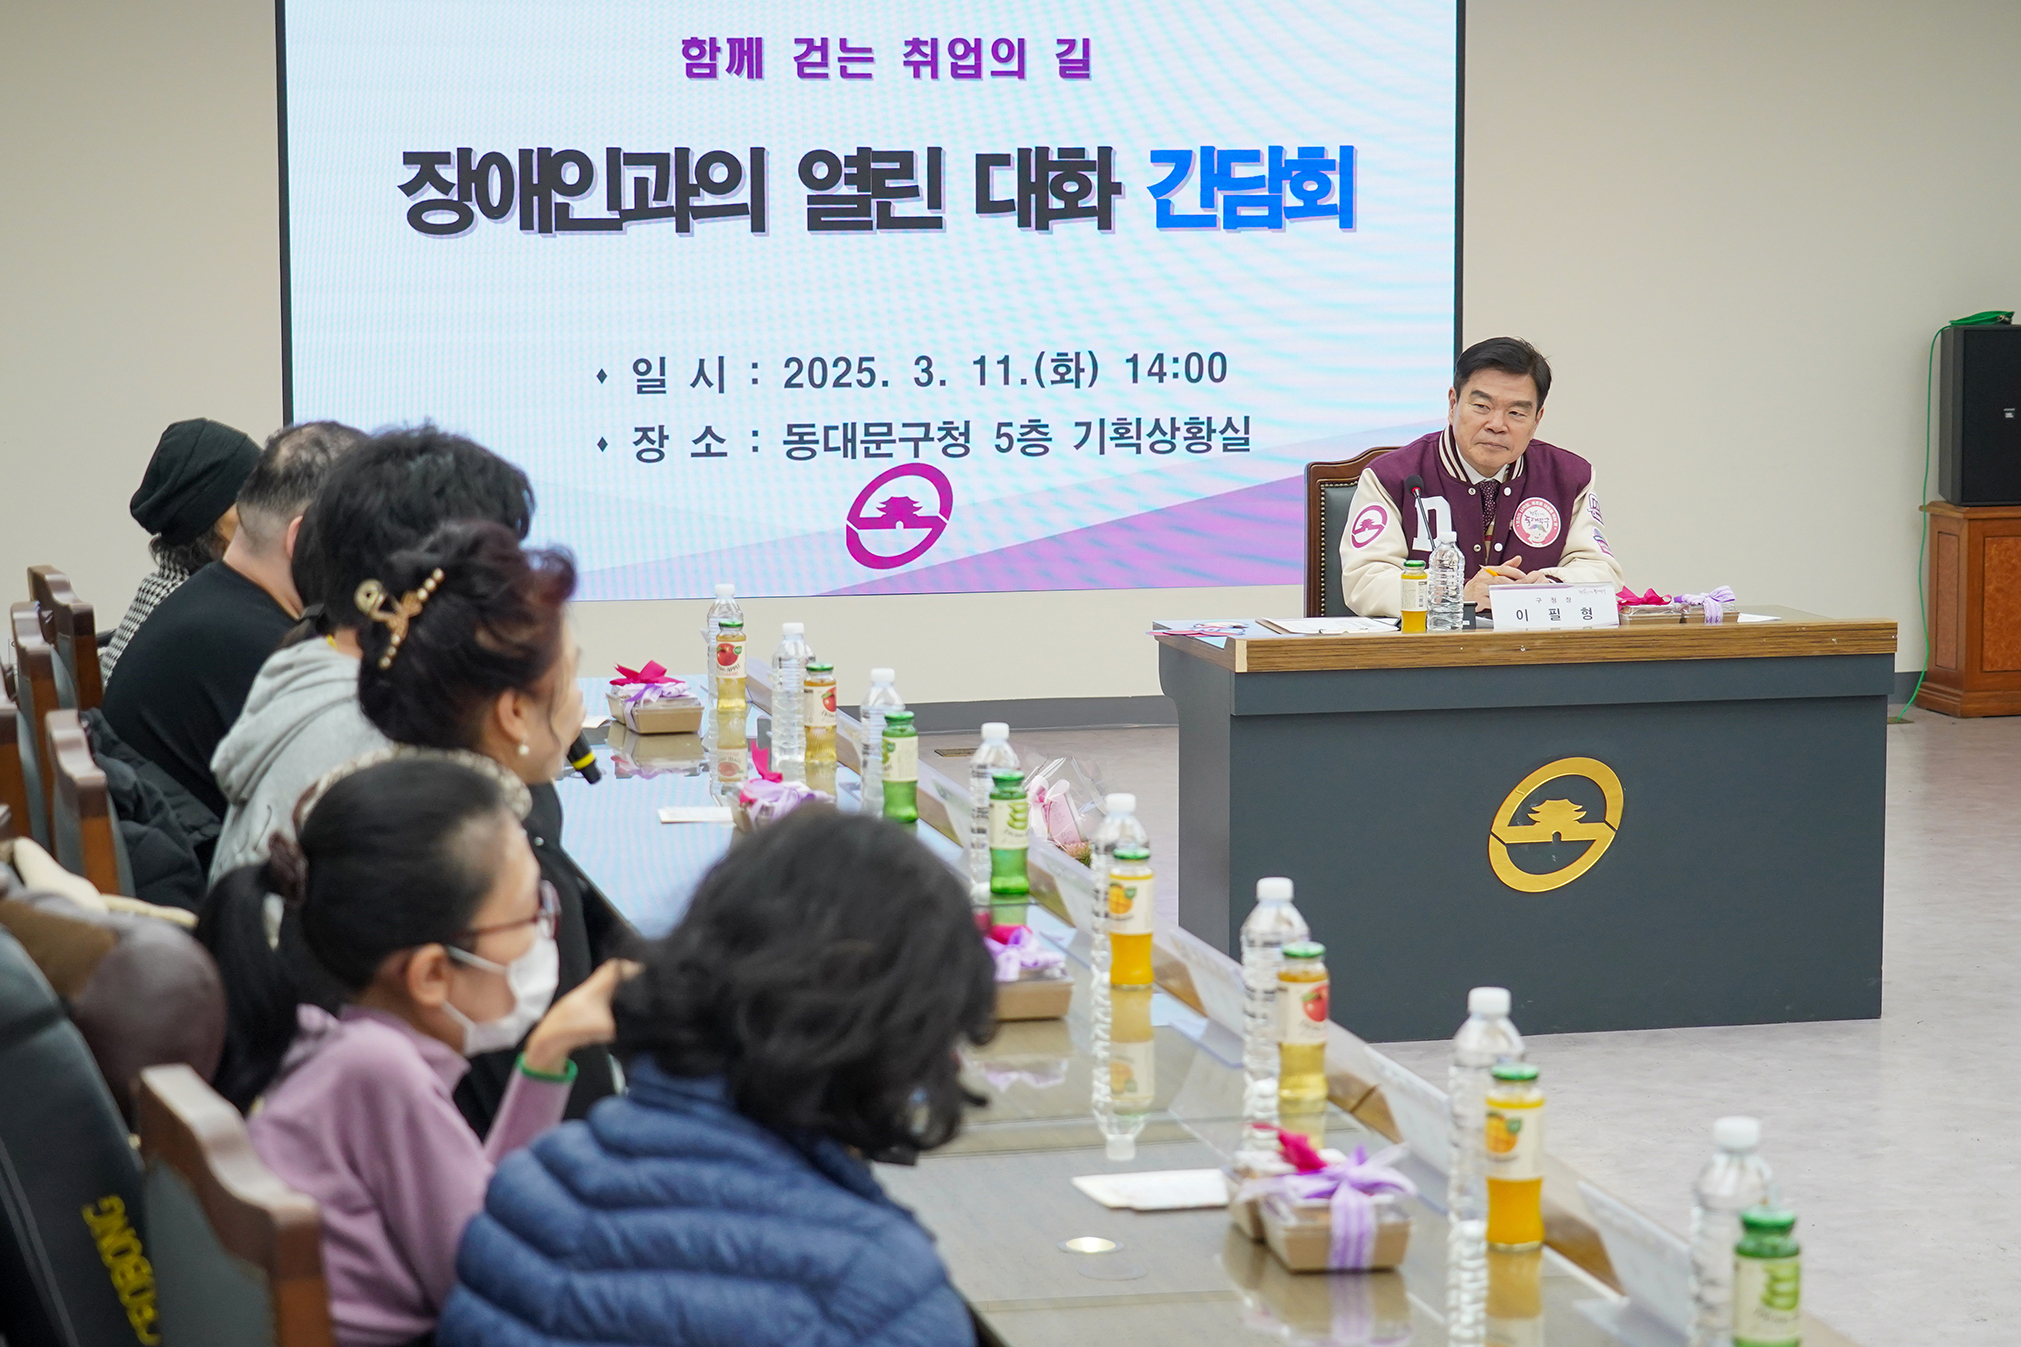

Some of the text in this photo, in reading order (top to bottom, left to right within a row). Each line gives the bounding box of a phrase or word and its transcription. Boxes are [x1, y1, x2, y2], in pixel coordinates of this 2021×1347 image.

[681, 37, 1092, 80] 함께 걷는 취업의 길
[397, 145, 1356, 236] 장애인과의 열린 대화 간담회
[632, 356, 667, 395] 일
[690, 356, 726, 394] 시
[784, 356, 890, 389] 2025.
[913, 356, 947, 387] 3.
[972, 350, 1099, 389] 11.(화)
[1125, 351, 1228, 384] 14:00
[632, 424, 670, 463] 장
[690, 425, 728, 458] 소
[783, 420, 971, 460] 동대문구청
[994, 418, 1053, 457] 5층
[1073, 415, 1251, 455] 기획상황실
